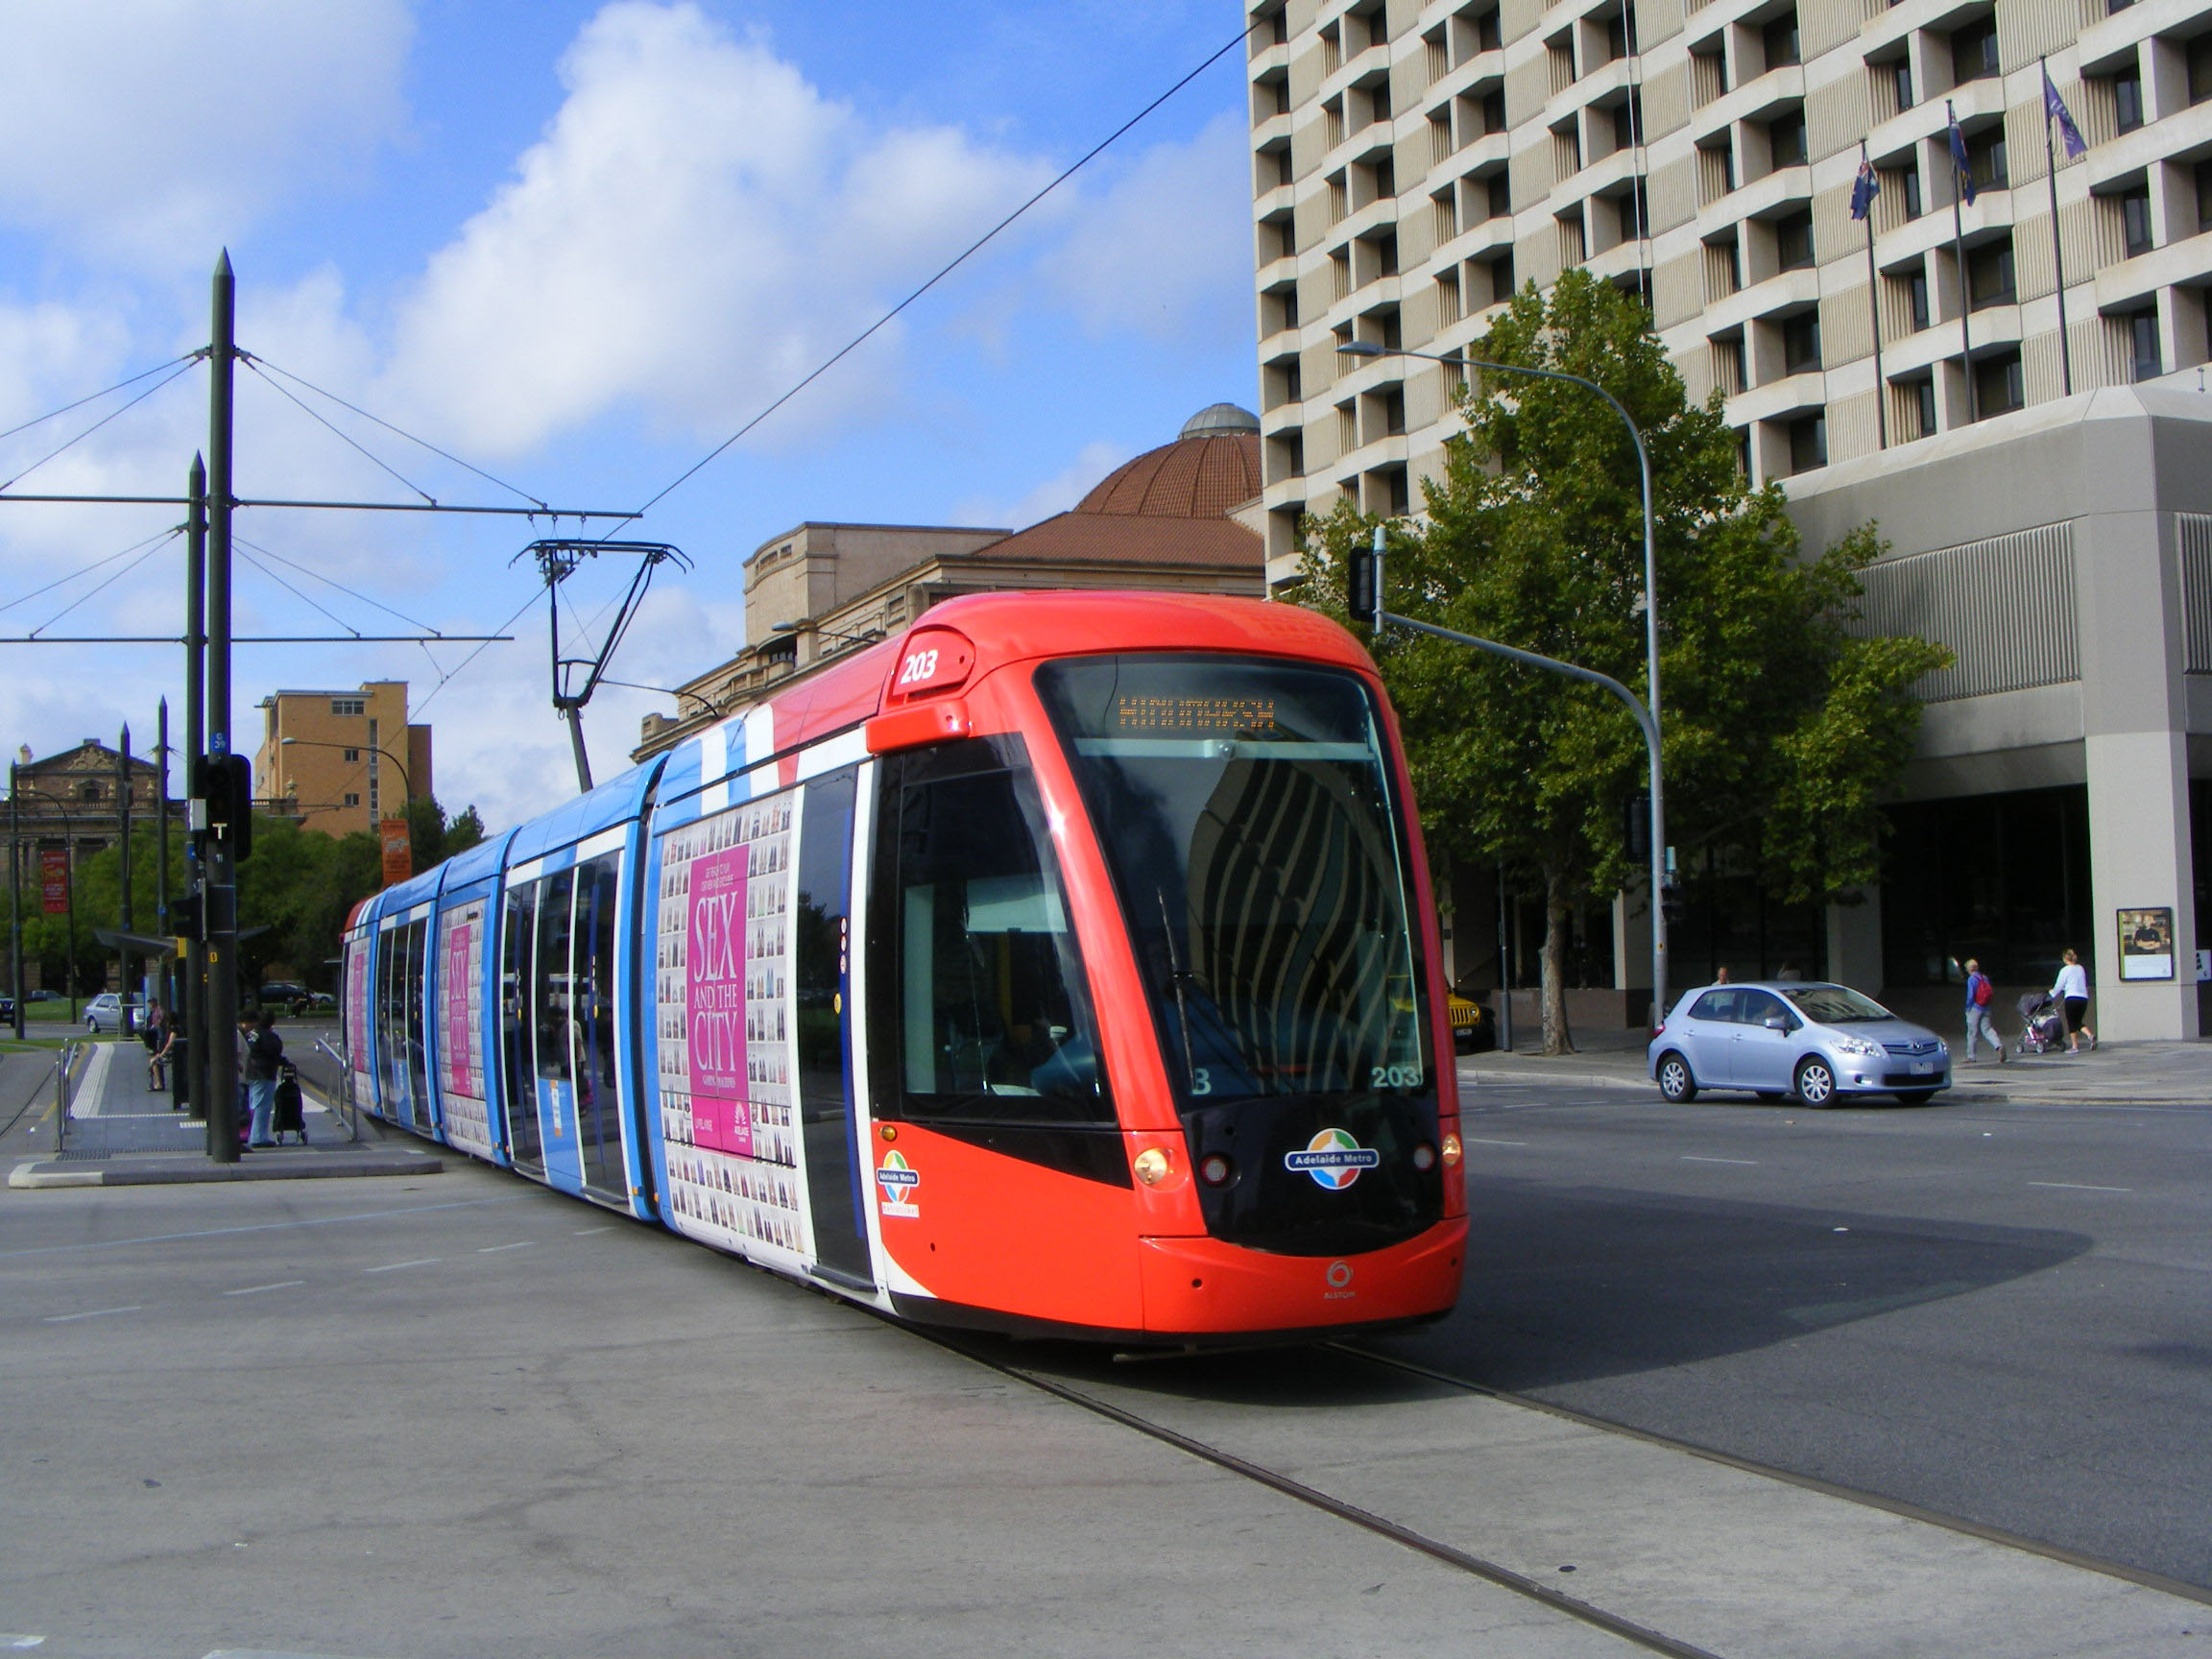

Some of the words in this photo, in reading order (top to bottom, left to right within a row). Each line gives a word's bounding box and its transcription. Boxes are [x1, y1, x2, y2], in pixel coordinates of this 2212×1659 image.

[900, 649, 939, 685] 203
[1119, 698, 1274, 728] HINDMARSH
[212, 823, 228, 840] T
[694, 891, 738, 983] SEX
[694, 985, 715, 1009] AND
[717, 984, 737, 1007] THE
[694, 1011, 738, 1072] CITY
[1372, 1066, 1420, 1088] 203
[1295, 1155, 1341, 1166] Adelaide
[1344, 1154, 1373, 1164] Metro
[879, 1172, 899, 1182] Adelaide
[901, 1173, 916, 1183] Metro
